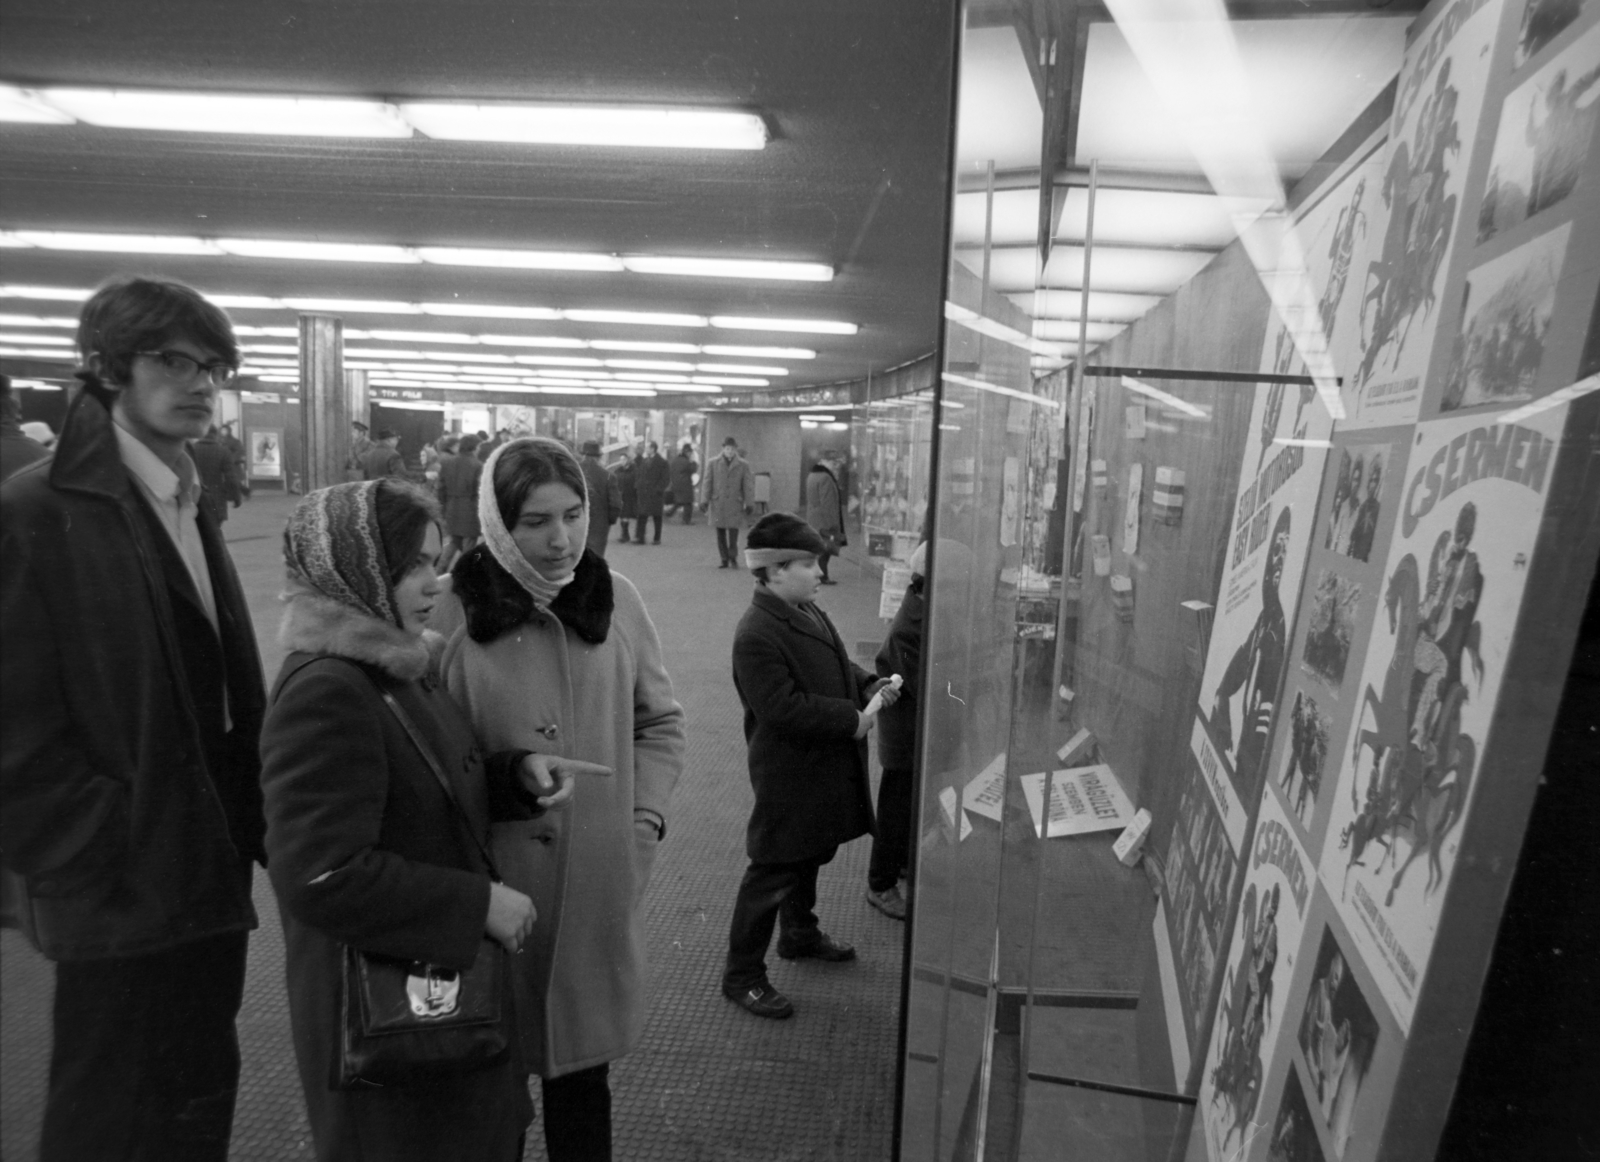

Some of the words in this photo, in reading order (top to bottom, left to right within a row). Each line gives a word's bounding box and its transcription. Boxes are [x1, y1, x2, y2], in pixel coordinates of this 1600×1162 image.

[1393, 0, 1490, 139] CSERM
[1402, 424, 1555, 539] CSERMEN
[1061, 781, 1087, 815] SZEMBEN
[1079, 771, 1120, 819] VIRÁGÜZLET
[1253, 819, 1309, 920] CSERMEN
